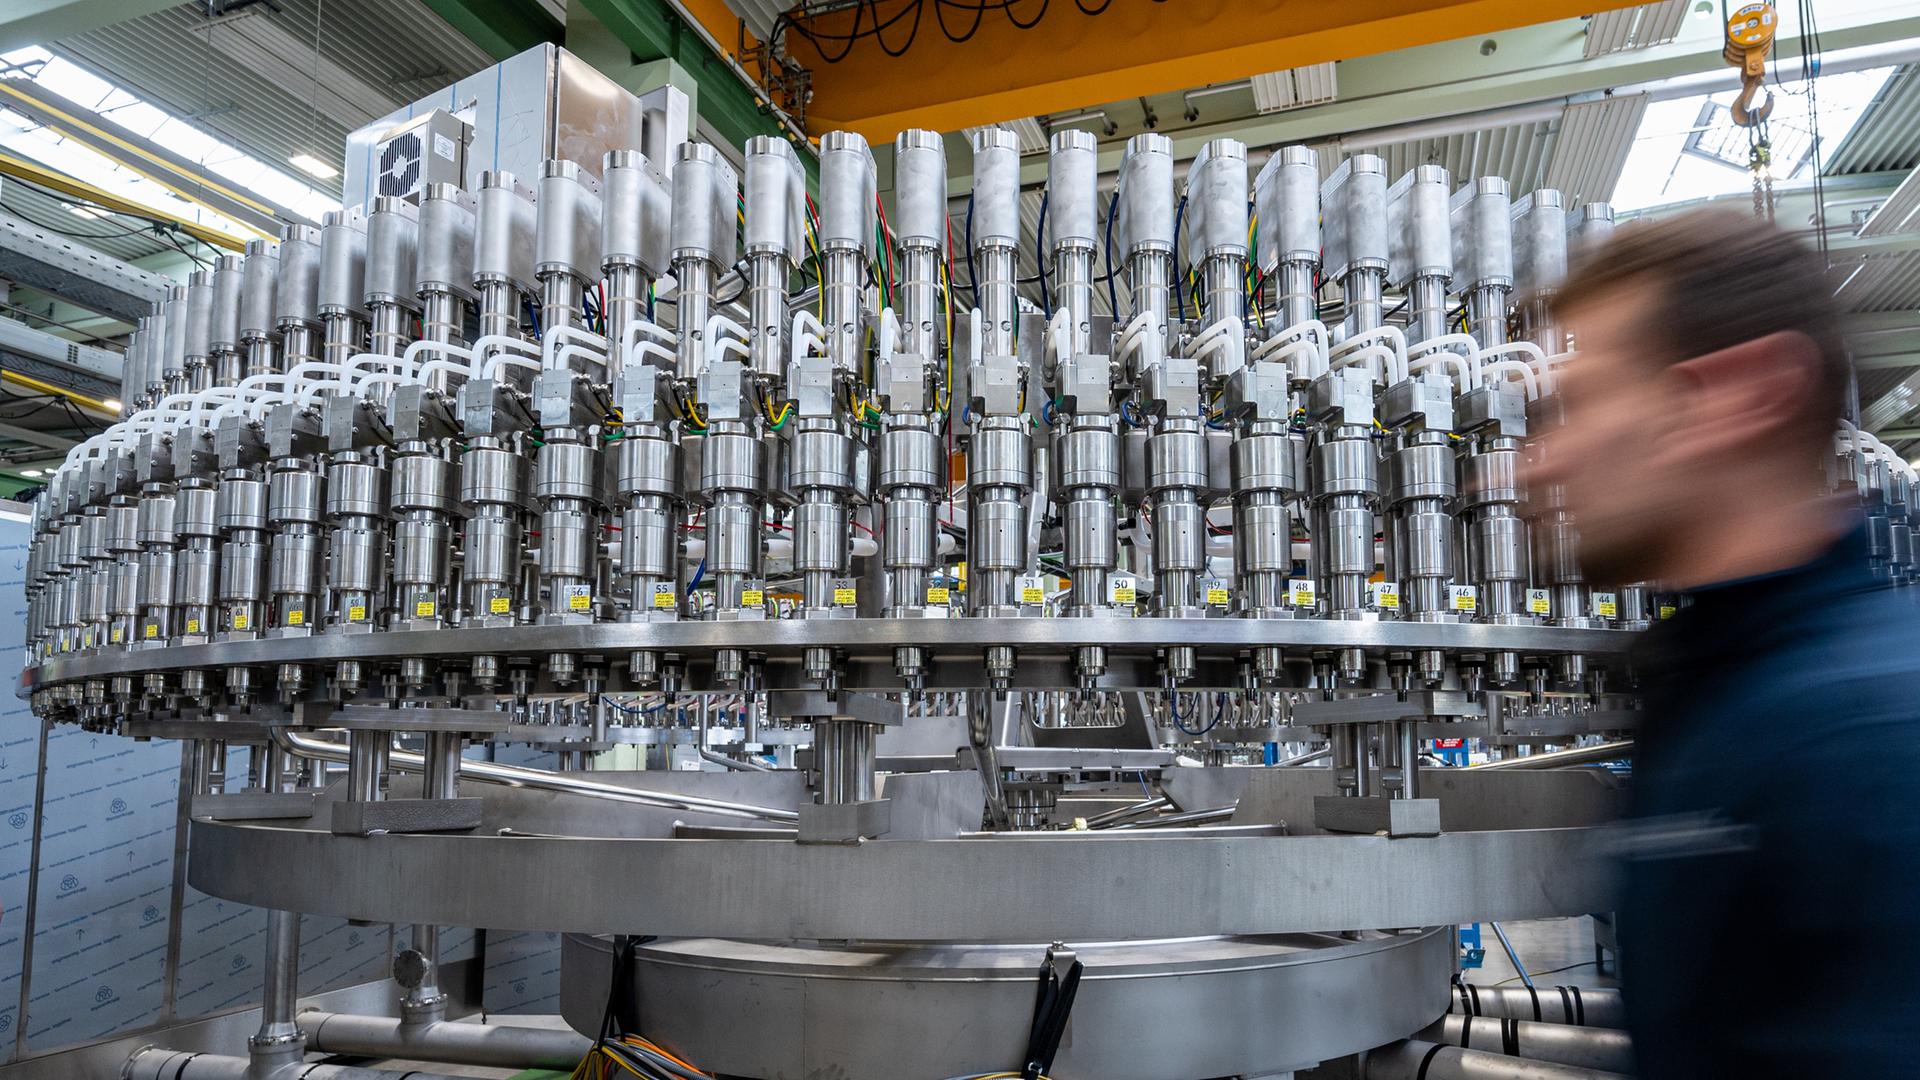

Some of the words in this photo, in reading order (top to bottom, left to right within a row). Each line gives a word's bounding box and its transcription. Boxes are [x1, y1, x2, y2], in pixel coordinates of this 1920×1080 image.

[835, 580, 848, 589] 53
[1023, 579, 1035, 588] 51
[1114, 579, 1128, 589] 50
[1207, 581, 1220, 590] 49
[1295, 582, 1308, 592] 48
[655, 584, 668, 593] 55
[1380, 585, 1392, 594] 47
[1456, 588, 1469, 597] 46
[1532, 591, 1543, 600] 45
[1599, 595, 1610, 603] 44
